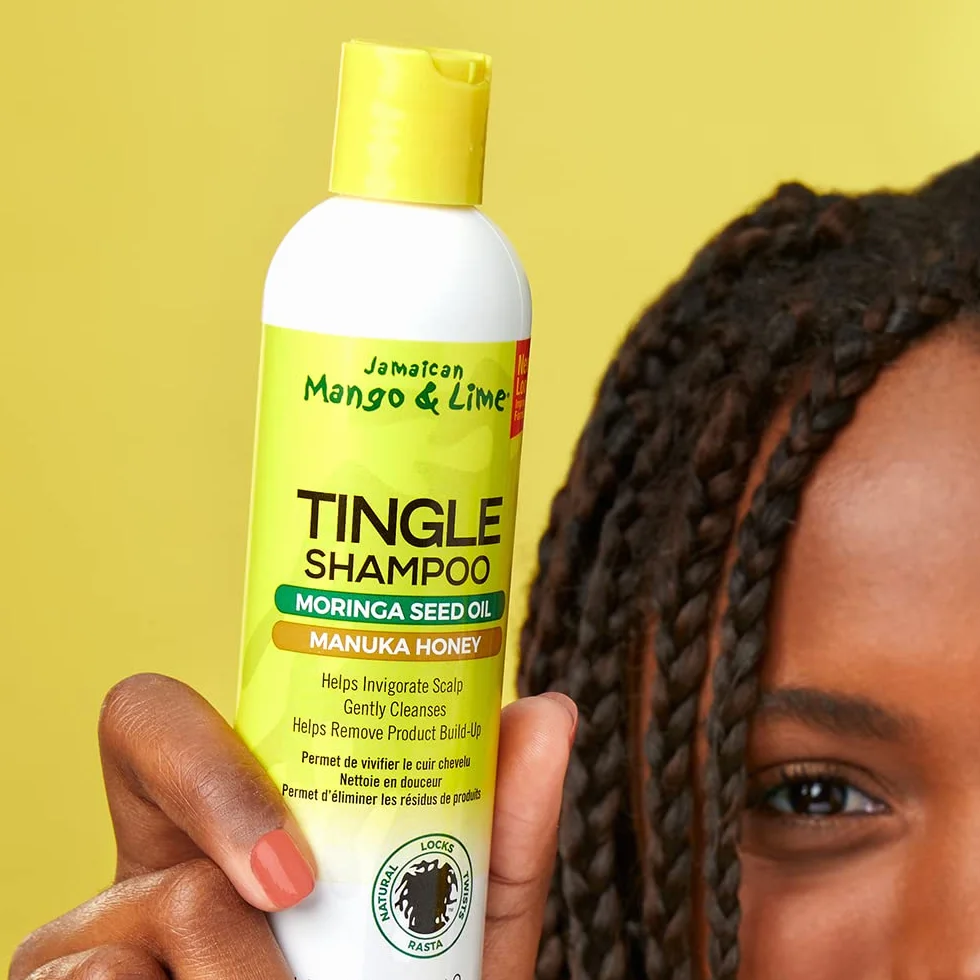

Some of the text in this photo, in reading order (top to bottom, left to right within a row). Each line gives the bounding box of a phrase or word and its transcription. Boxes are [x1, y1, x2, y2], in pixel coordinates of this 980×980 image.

[364, 356, 463, 380] Jamaican
[304, 374, 405, 412] Mango
[415, 381, 440, 416] &
[297, 489, 503, 548] TINGLE
[304, 549, 490, 586] SHAMPOO
[295, 593, 492, 621] MORINGA SEED OIL
[309, 631, 481, 656] MANUKA HONEY
[322, 672, 463, 696] Helps Invigorate Scalp
[343, 699, 446, 720] Gently Cleanses
[293, 717, 482, 741] Helps Remove Product Build-Up
[301, 751, 471, 771] Permet de vivifier le cuir chevelu
[340, 773, 443, 789] Nettoie en douceur
[282, 784, 481, 807] Permet d'éliminer les résidus de produits
[421, 840, 455, 853] LOCKS
[378, 865, 399, 922] NATURAL
[458, 870, 470, 920] TWISTS
[408, 940, 443, 951] RASTA
